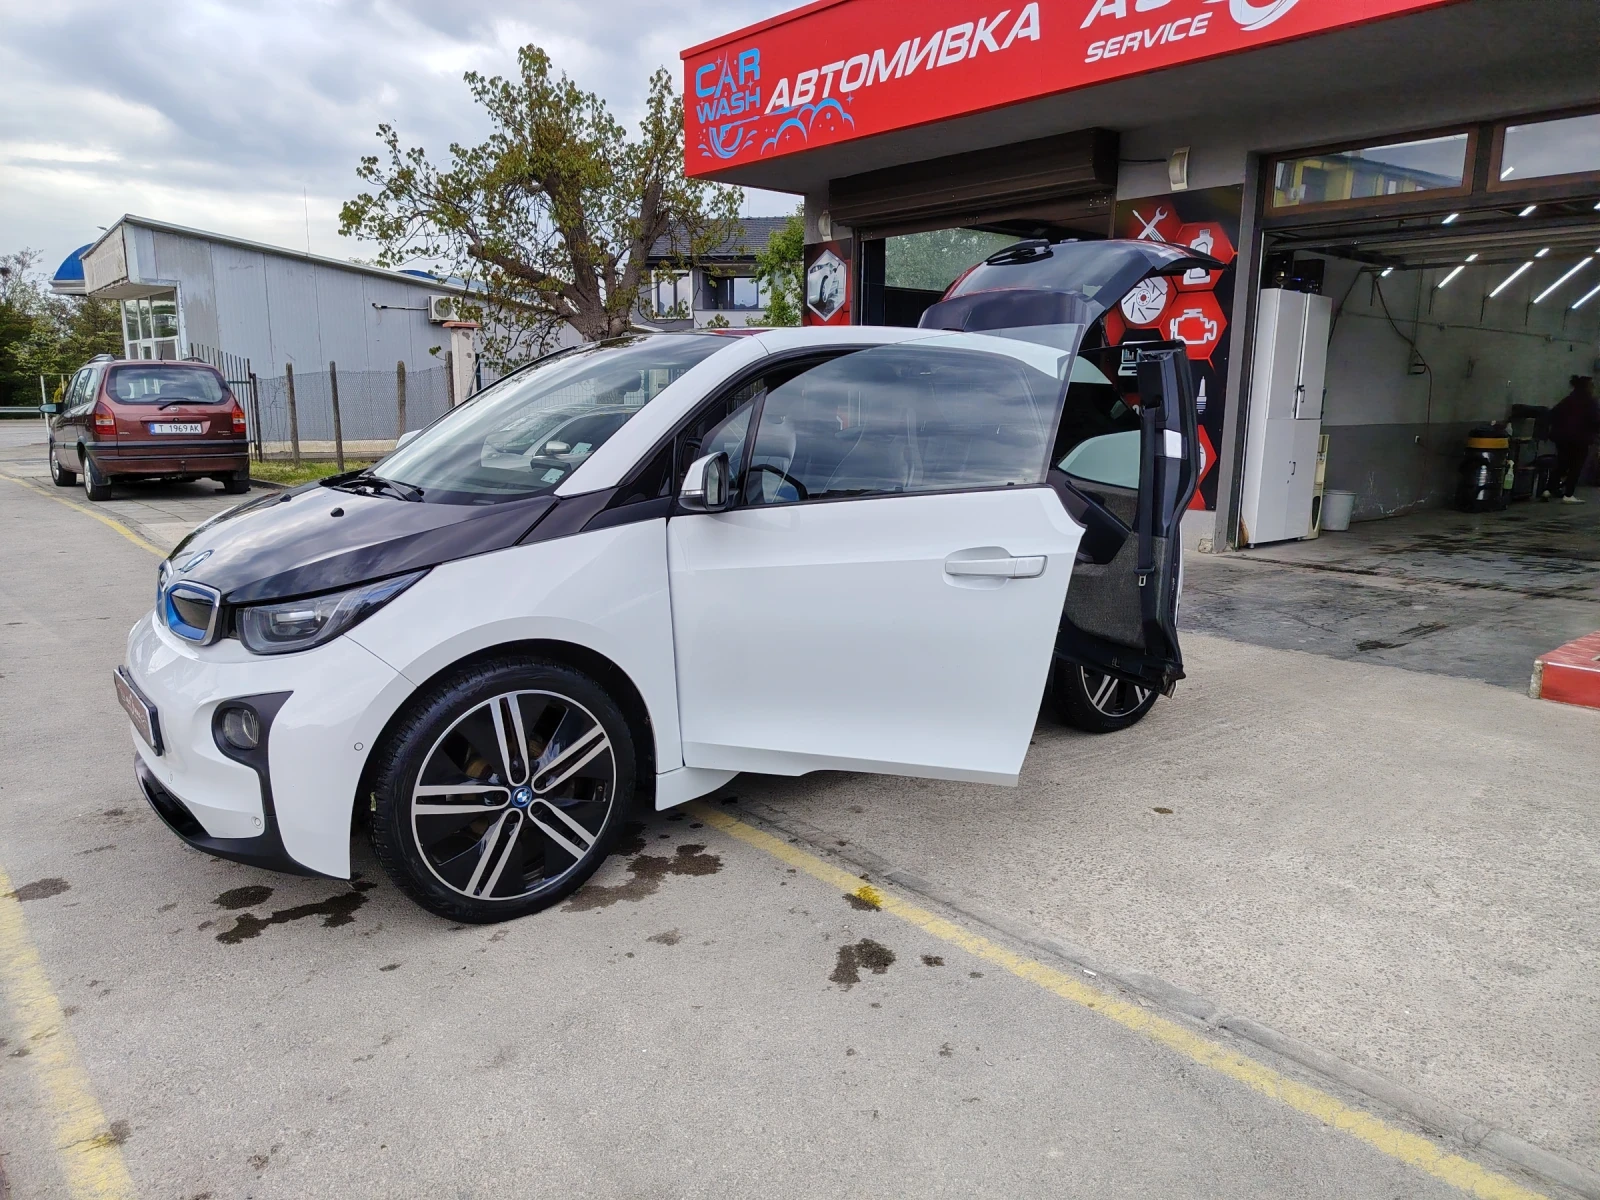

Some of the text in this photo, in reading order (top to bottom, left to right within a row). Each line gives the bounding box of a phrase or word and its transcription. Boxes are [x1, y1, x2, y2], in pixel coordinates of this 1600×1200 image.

[764, 2, 1041, 114] АВТОМИВКА
[1084, 12, 1213, 63] SERVICE
[695, 48, 760, 98] CAR
[696, 86, 761, 124] WASH
[158, 424, 200, 432] T 1969 AK
